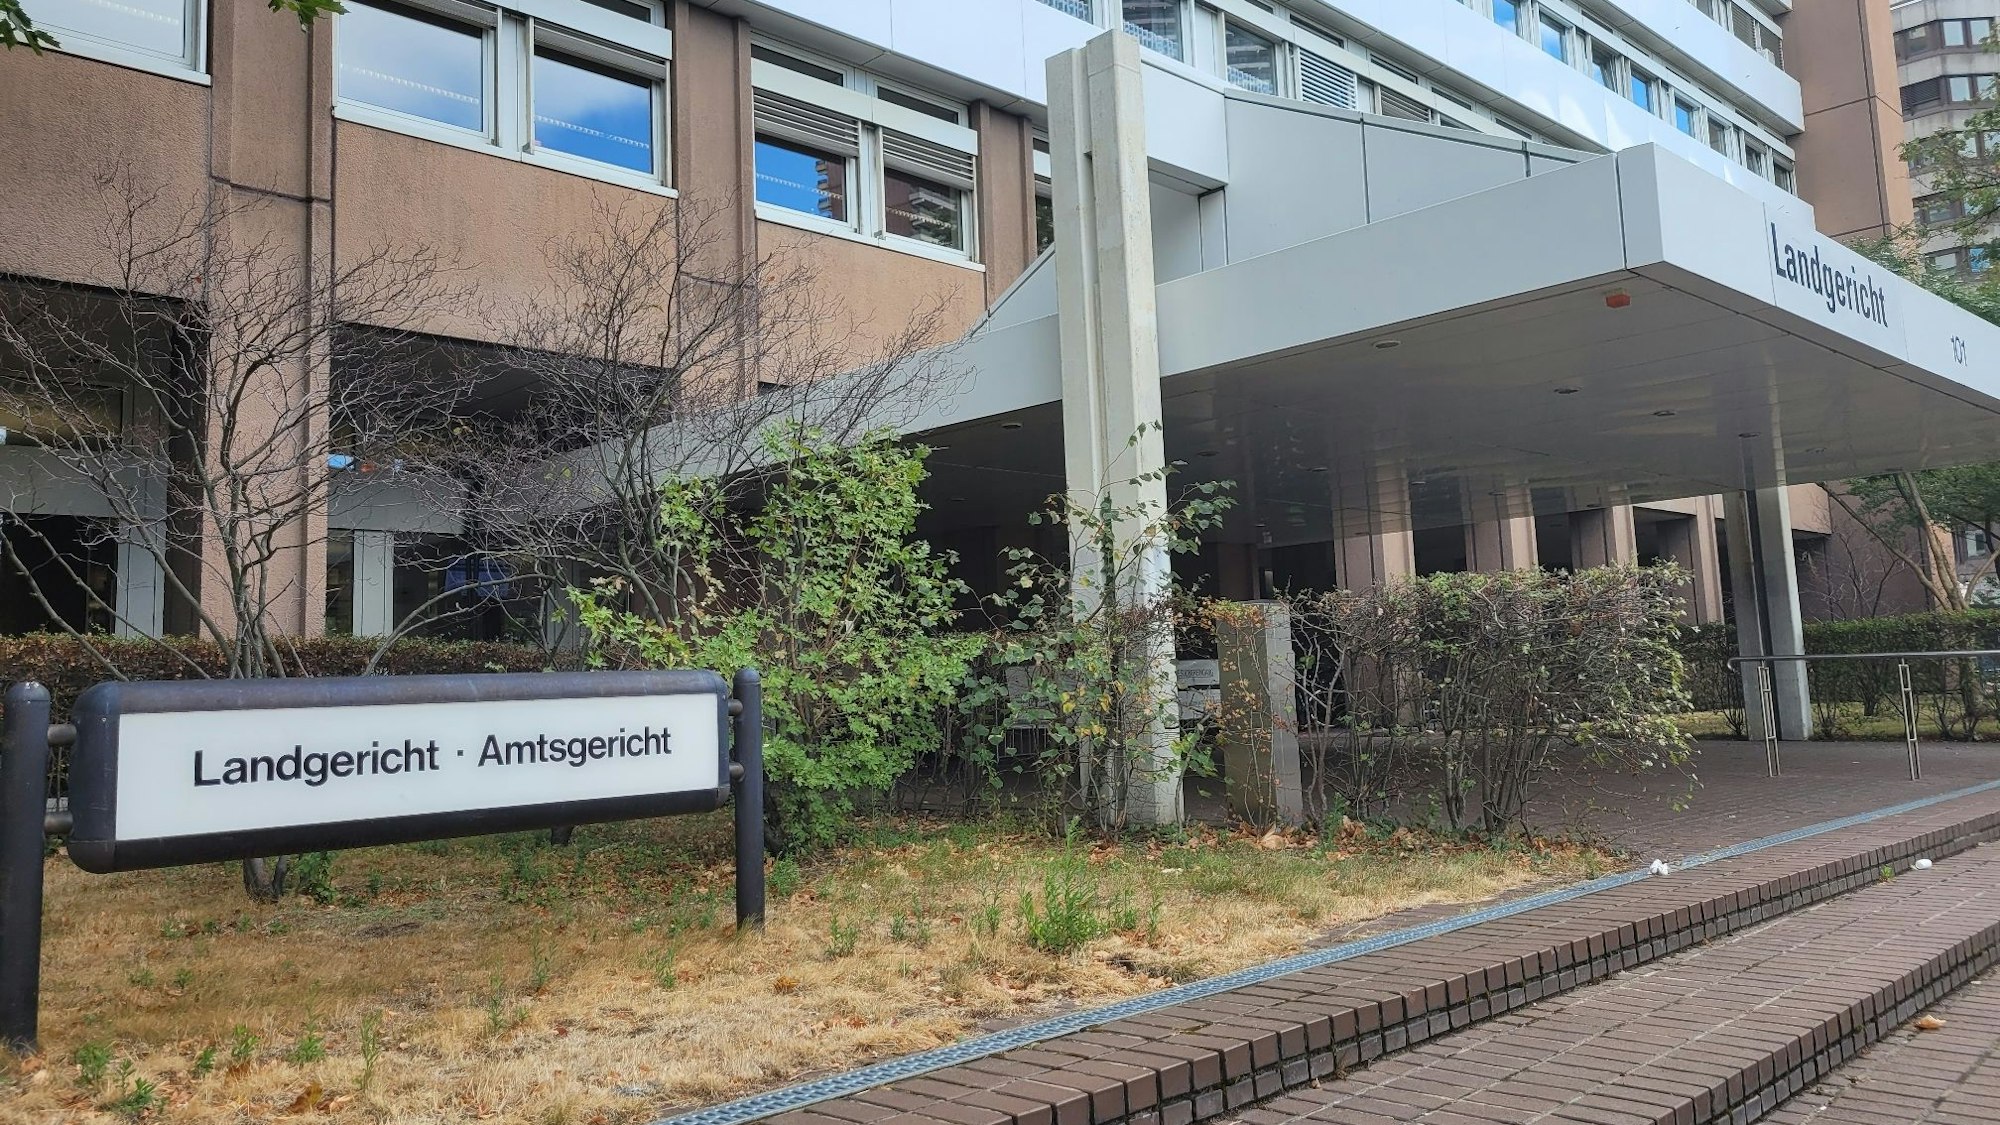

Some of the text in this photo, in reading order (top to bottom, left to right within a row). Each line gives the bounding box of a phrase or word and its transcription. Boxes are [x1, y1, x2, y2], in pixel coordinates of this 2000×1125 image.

[1771, 223, 1888, 327] Landgericht
[1951, 335, 1967, 366] 101
[194, 739, 440, 787] Landgericht
[477, 726, 672, 768] Amtsgericht
